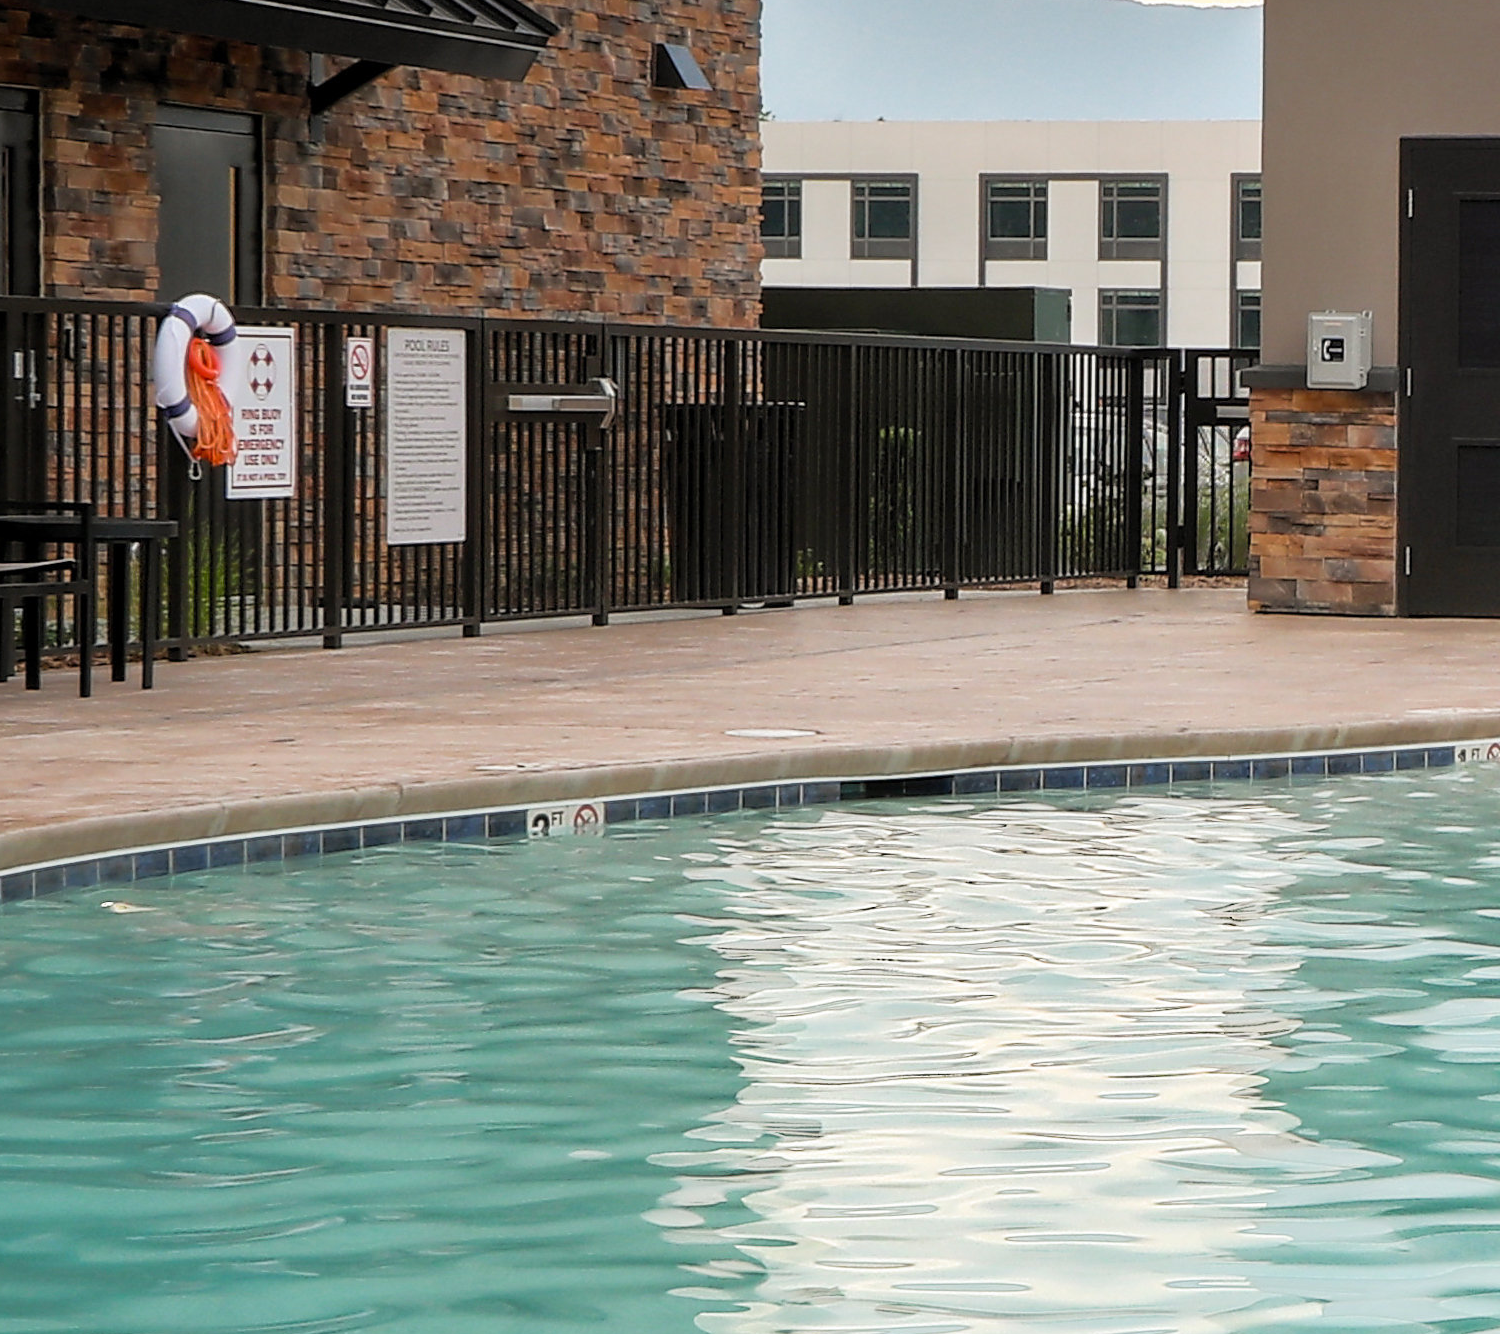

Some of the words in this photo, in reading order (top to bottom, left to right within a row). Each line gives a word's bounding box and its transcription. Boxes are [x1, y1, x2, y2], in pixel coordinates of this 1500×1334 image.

[404, 339, 426, 352] POOL
[427, 339, 450, 353] RULES
[241, 409, 260, 419] RING
[261, 409, 281, 420] BUOY
[258, 424, 273, 435] FOR
[237, 439, 284, 450] EMERGENCY
[244, 454, 259, 465] USE
[261, 454, 279, 465] ONLY
[551, 811, 564, 826] FT
